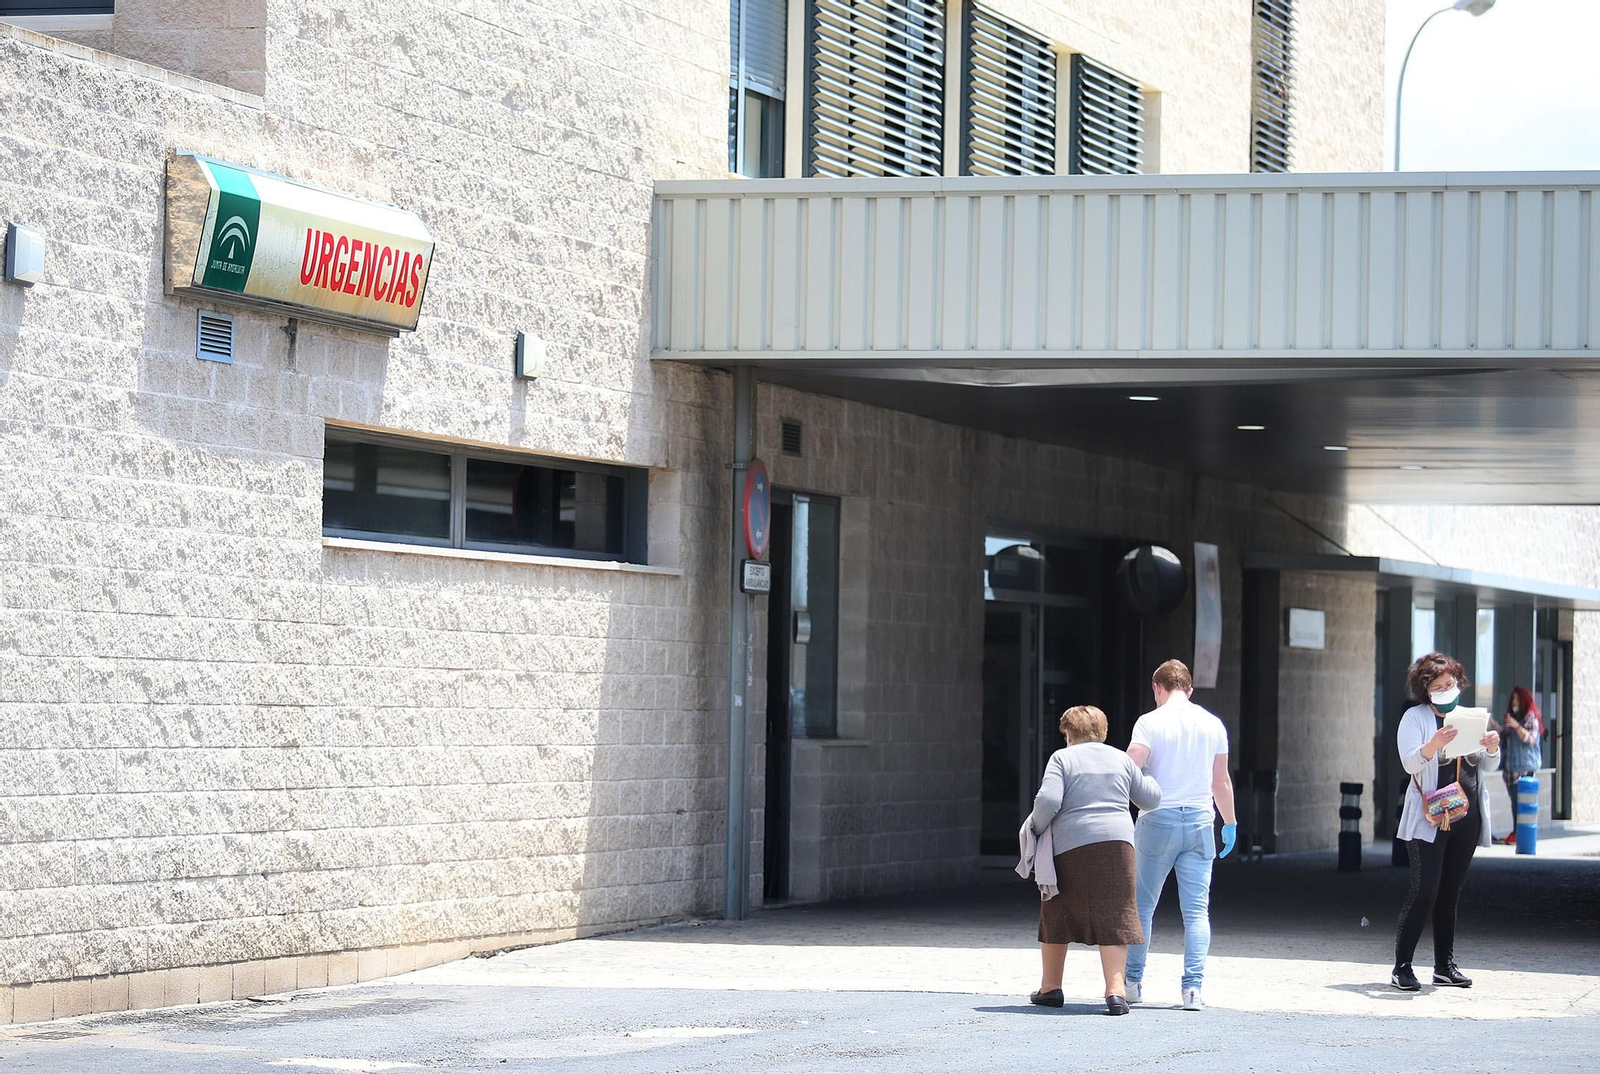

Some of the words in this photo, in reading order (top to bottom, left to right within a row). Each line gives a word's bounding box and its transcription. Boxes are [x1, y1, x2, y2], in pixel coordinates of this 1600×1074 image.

[210, 259, 222, 270] JUNTA
[222, 261, 228, 271] DE
[300, 228, 423, 308] URGENCIAS
